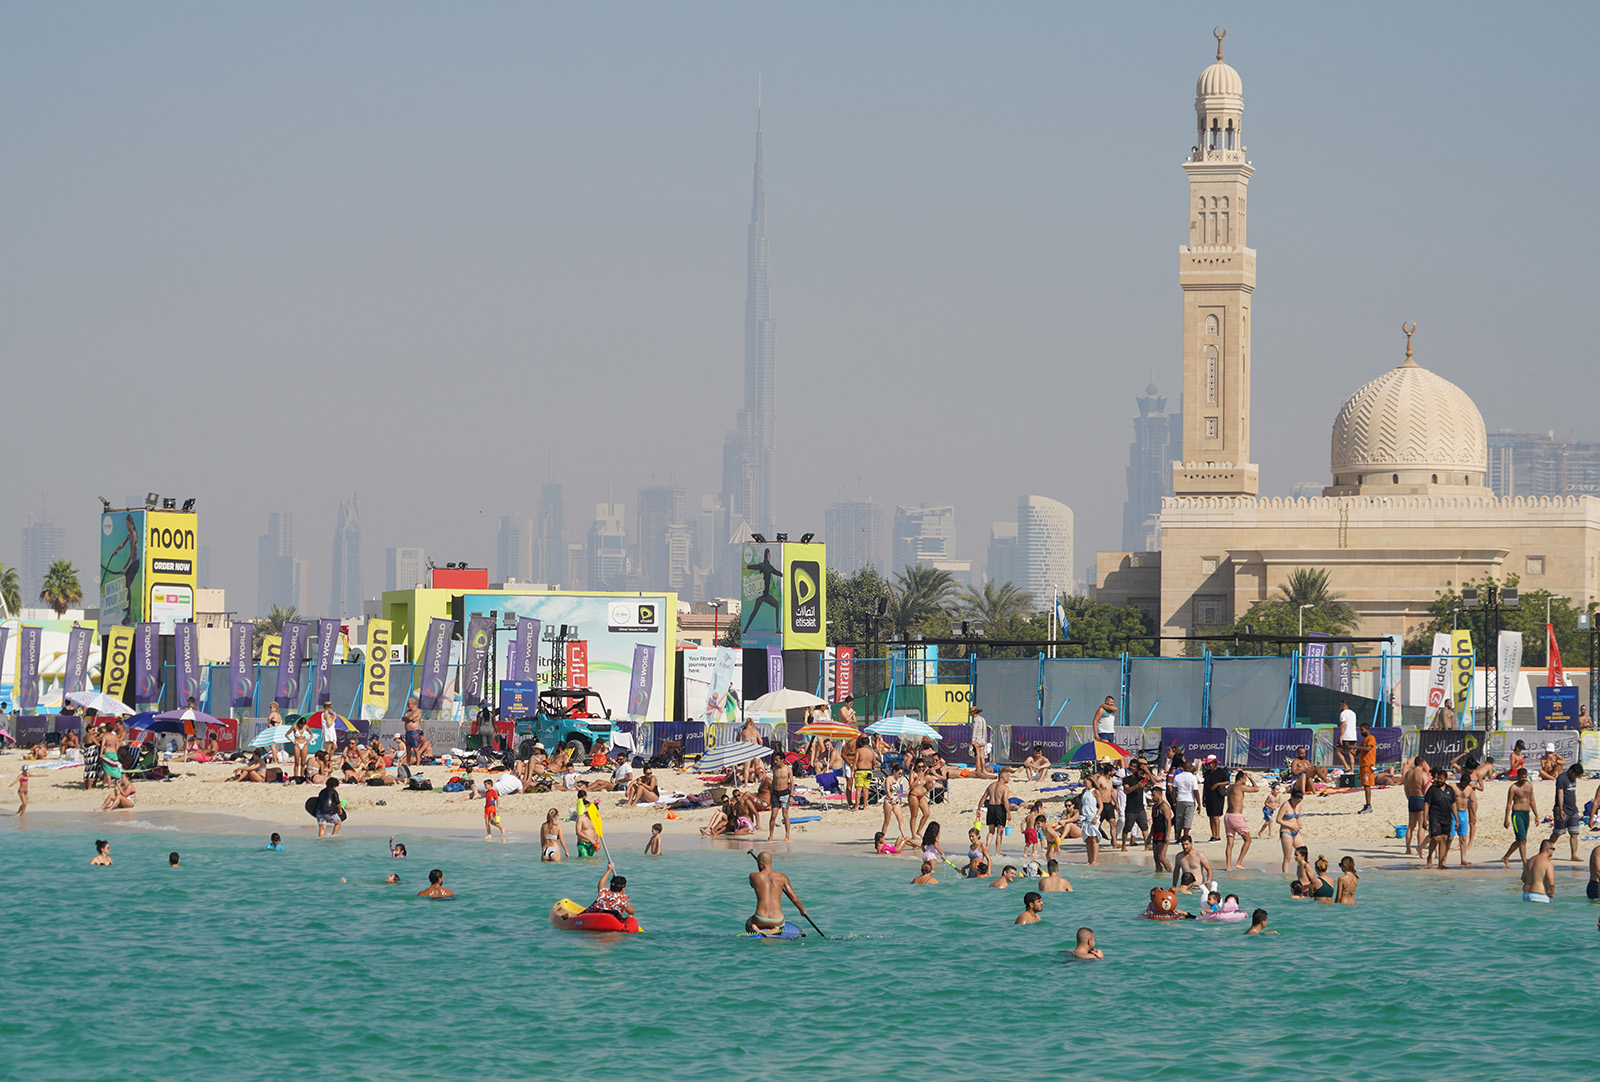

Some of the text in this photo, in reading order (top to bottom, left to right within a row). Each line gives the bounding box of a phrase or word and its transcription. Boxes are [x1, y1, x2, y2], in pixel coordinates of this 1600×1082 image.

[151, 527, 194, 550] noon
[154, 561, 191, 572] ORDER NOW
[796, 617, 817, 627] etisalat
[75, 631, 86, 676] DP WORLD
[106, 636, 129, 696] noon
[144, 626, 152, 671] DP WORLD
[239, 660, 246, 673] DP
[287, 626, 299, 673] DP WORLD
[321, 623, 333, 670] DP WORLD
[369, 629, 389, 696] noon
[433, 623, 446, 673] DP WORLD
[524, 622, 533, 673] DP WORLD
[29, 666, 35, 675] DP
[185, 663, 192, 673] DP
[640, 648, 649, 688] DP WORLD
[838, 652, 850, 703] mirates
[1340, 661, 1349, 693] salat
[1457, 639, 1472, 703] noon
[945, 690, 973, 703] noo
[1502, 675, 1510, 703] Aster
[1425, 739, 1464, 755] اتصالات
